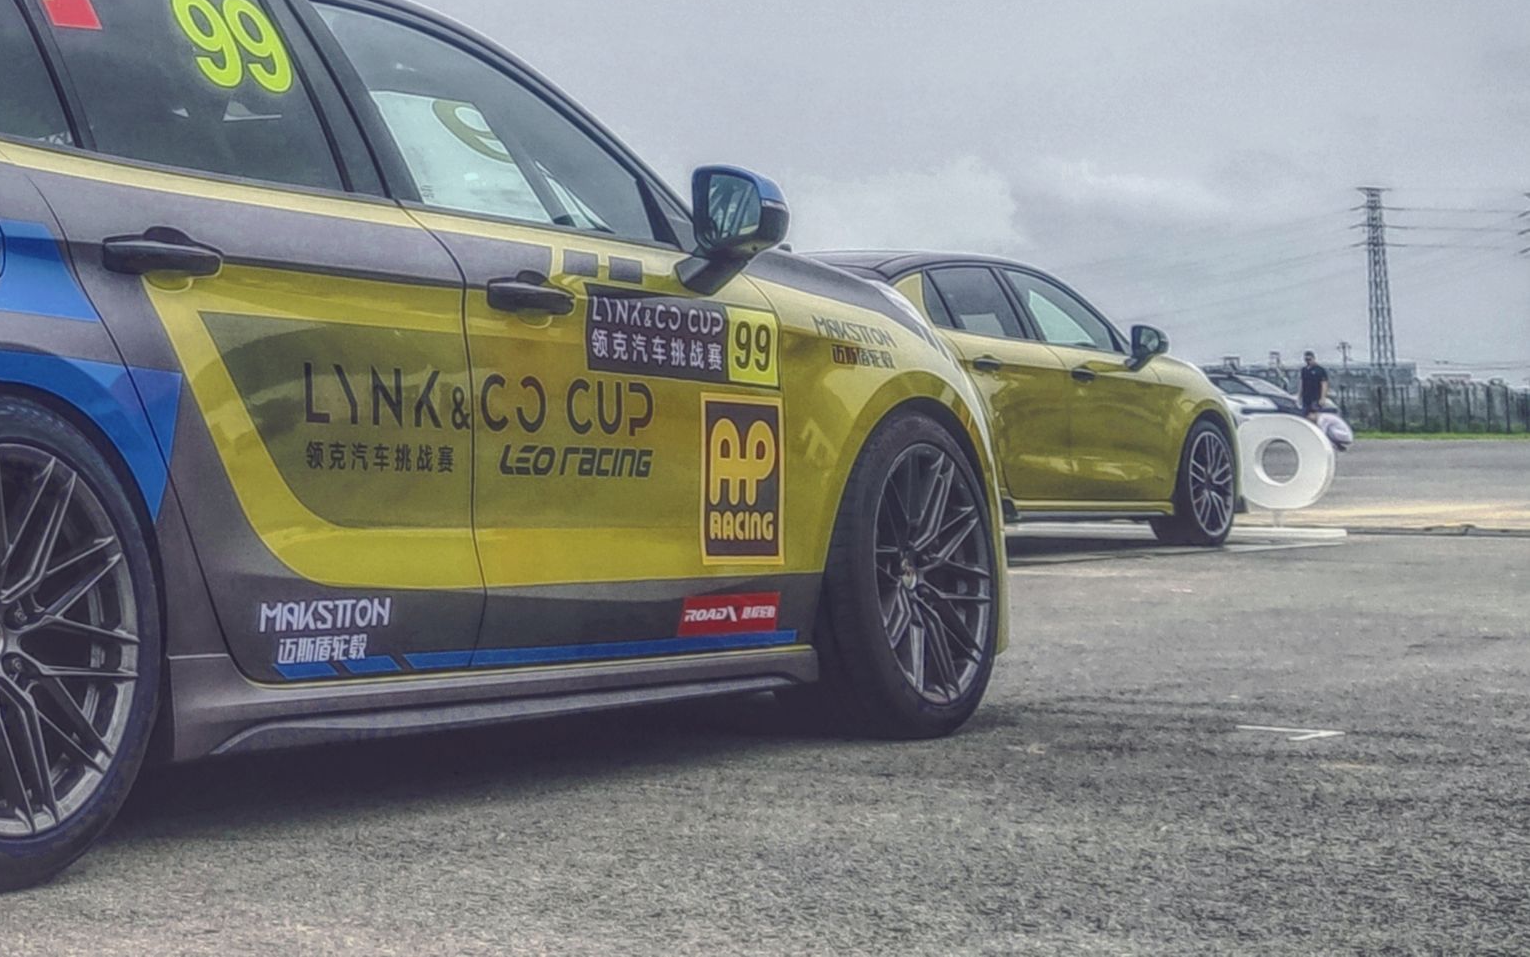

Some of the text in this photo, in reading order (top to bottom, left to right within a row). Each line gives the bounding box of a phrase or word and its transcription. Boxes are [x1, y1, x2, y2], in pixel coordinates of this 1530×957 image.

[687, 309, 724, 336] CUP
[591, 328, 723, 371] 领克汽车挑战赛
[734, 320, 771, 372] 99
[566, 378, 655, 437] CUP
[306, 441, 454, 474] 领克汽车挑战赛
[499, 444, 557, 476] LEO
[708, 417, 777, 506] AP
[708, 510, 775, 541] RACING
